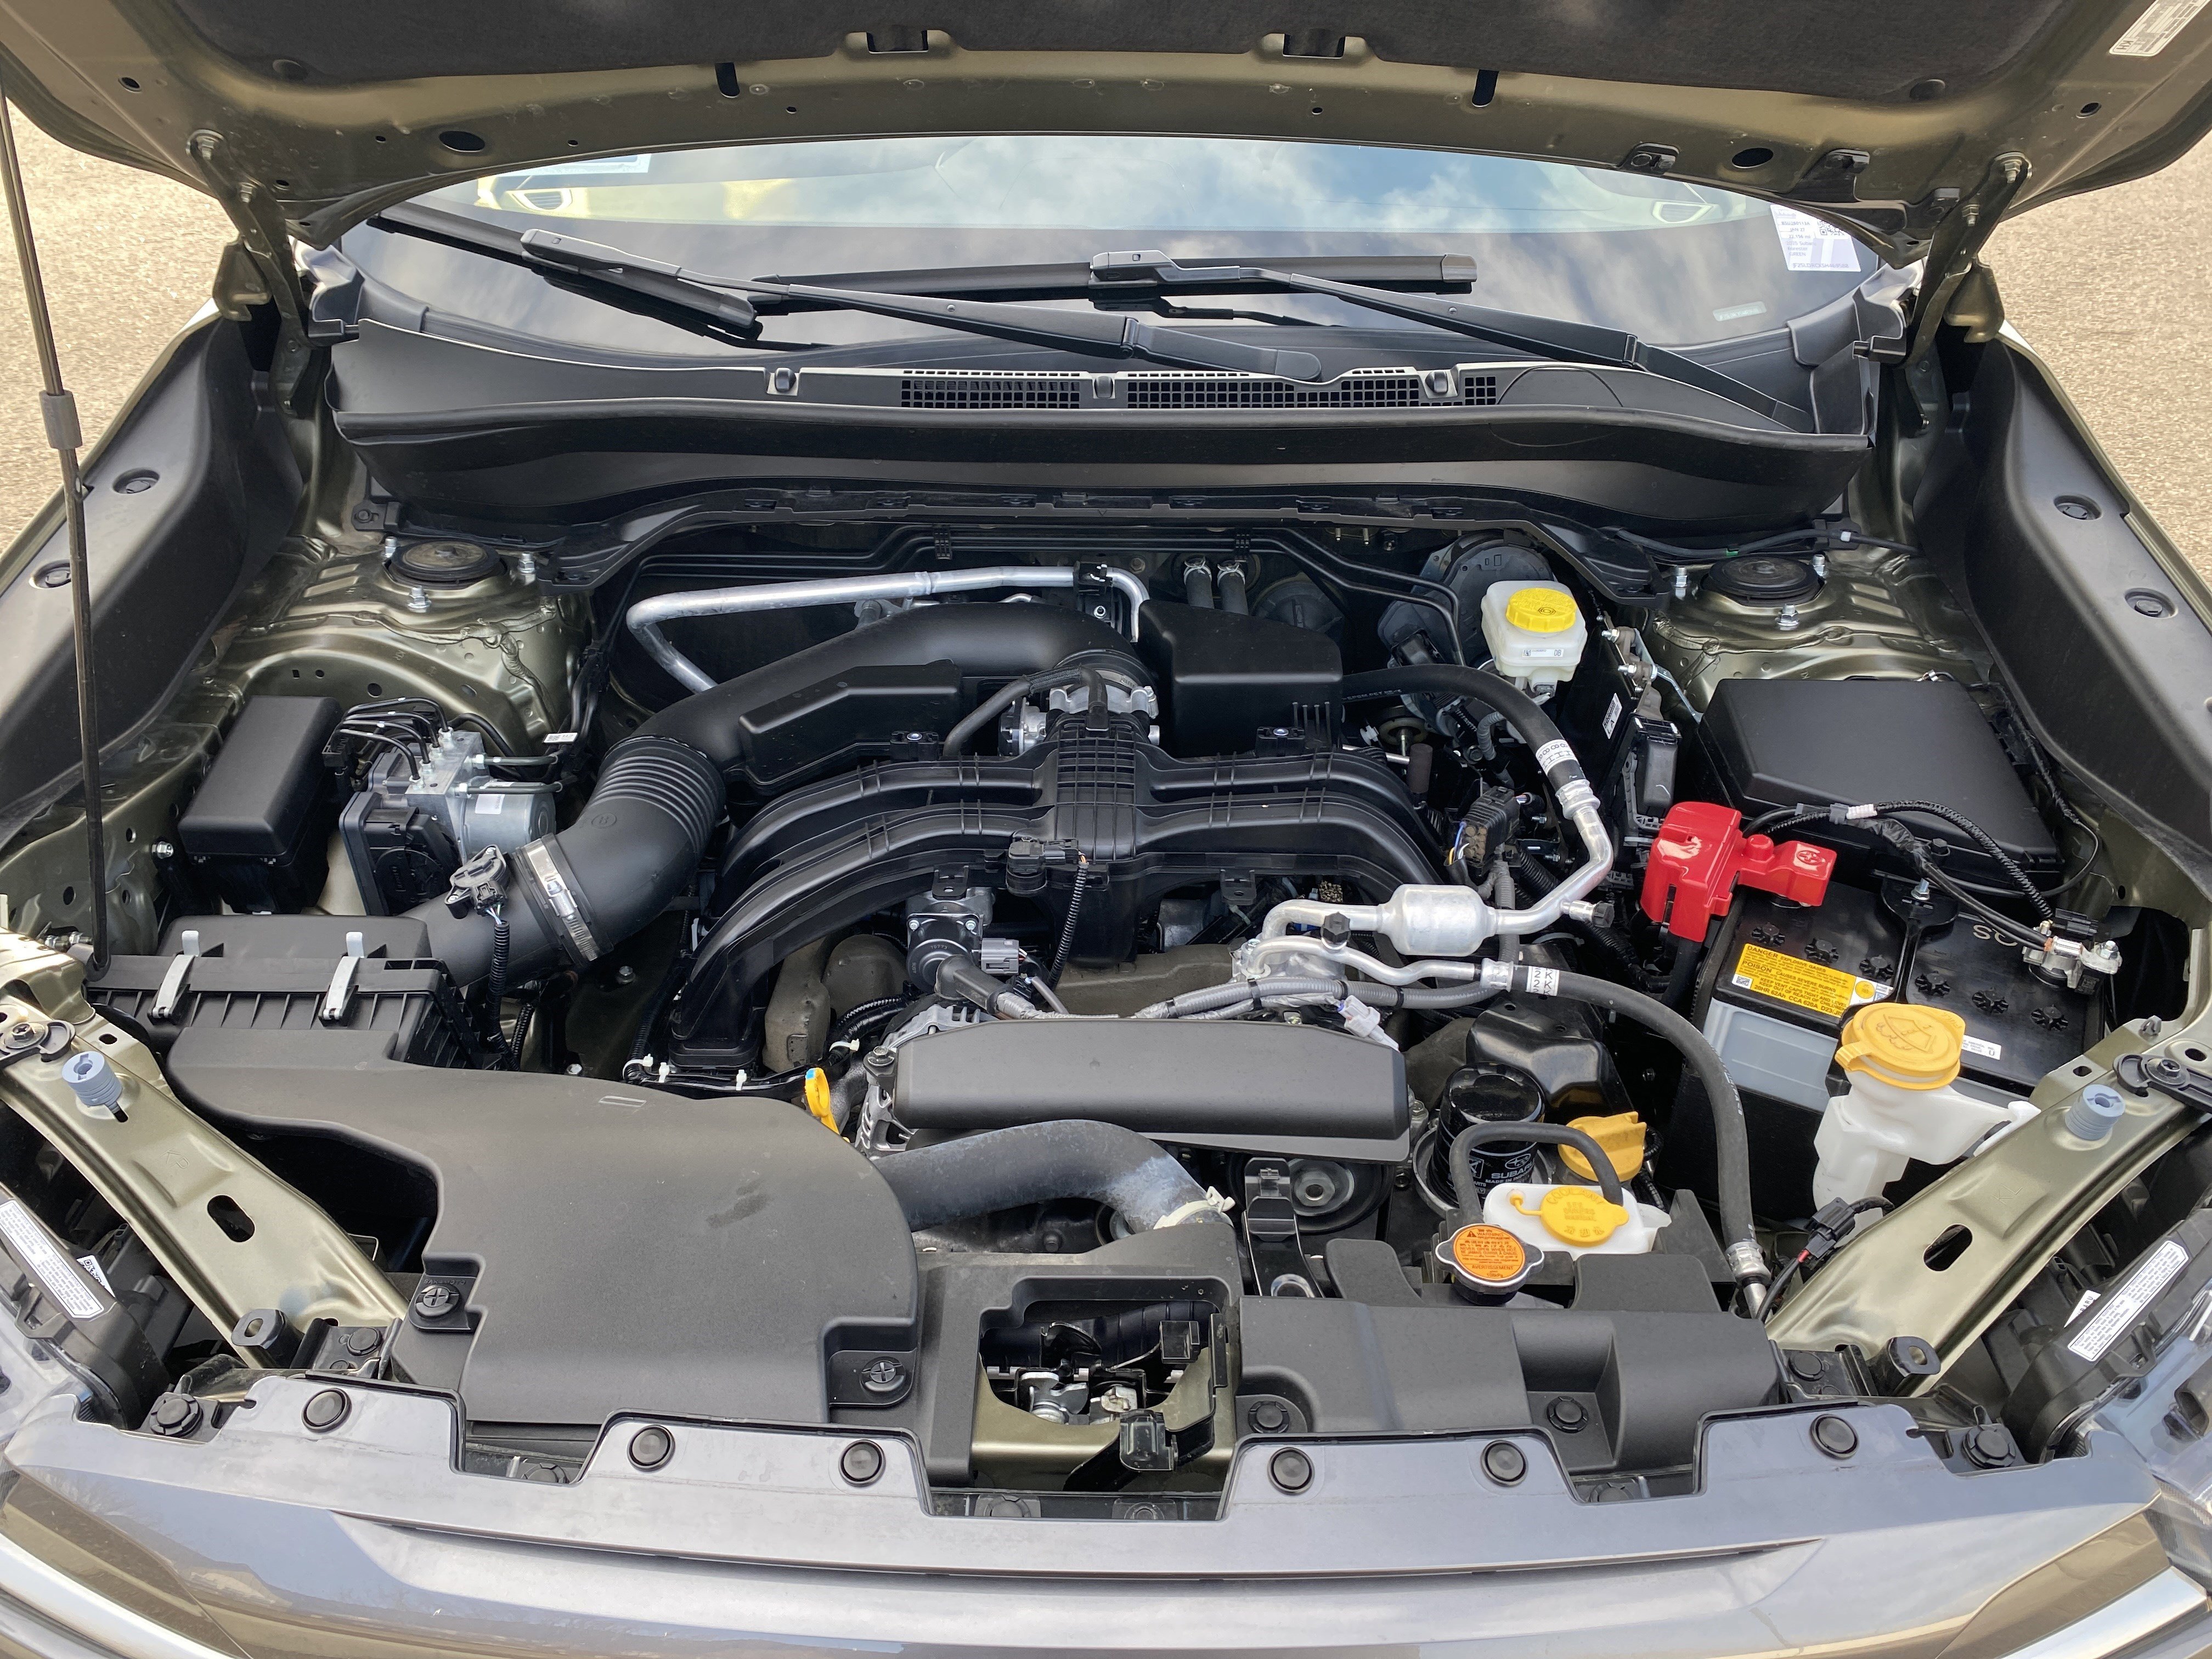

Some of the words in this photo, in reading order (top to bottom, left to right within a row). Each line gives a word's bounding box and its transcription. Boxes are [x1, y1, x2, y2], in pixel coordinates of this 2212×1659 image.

[1747, 945, 1779, 959] DANGER
[1780, 956, 1807, 967] EXPLOSIVE
[1808, 964, 1826, 973] GASES
[1742, 961, 1772, 973] POISON
[1776, 971, 1796, 980] CAUSES
[1797, 977, 1818, 986] SEVERE
[1818, 983, 1836, 993] BURNS
[1770, 989, 1786, 998] 62Ah
[1788, 995, 1802, 1005] CCA
[1788, 985, 1803, 994] CAPS
[1803, 989, 1819, 998] TIGHT
[1793, 991, 1812, 1001] REACH
[1546, 1187, 1605, 1205] COOLANT
